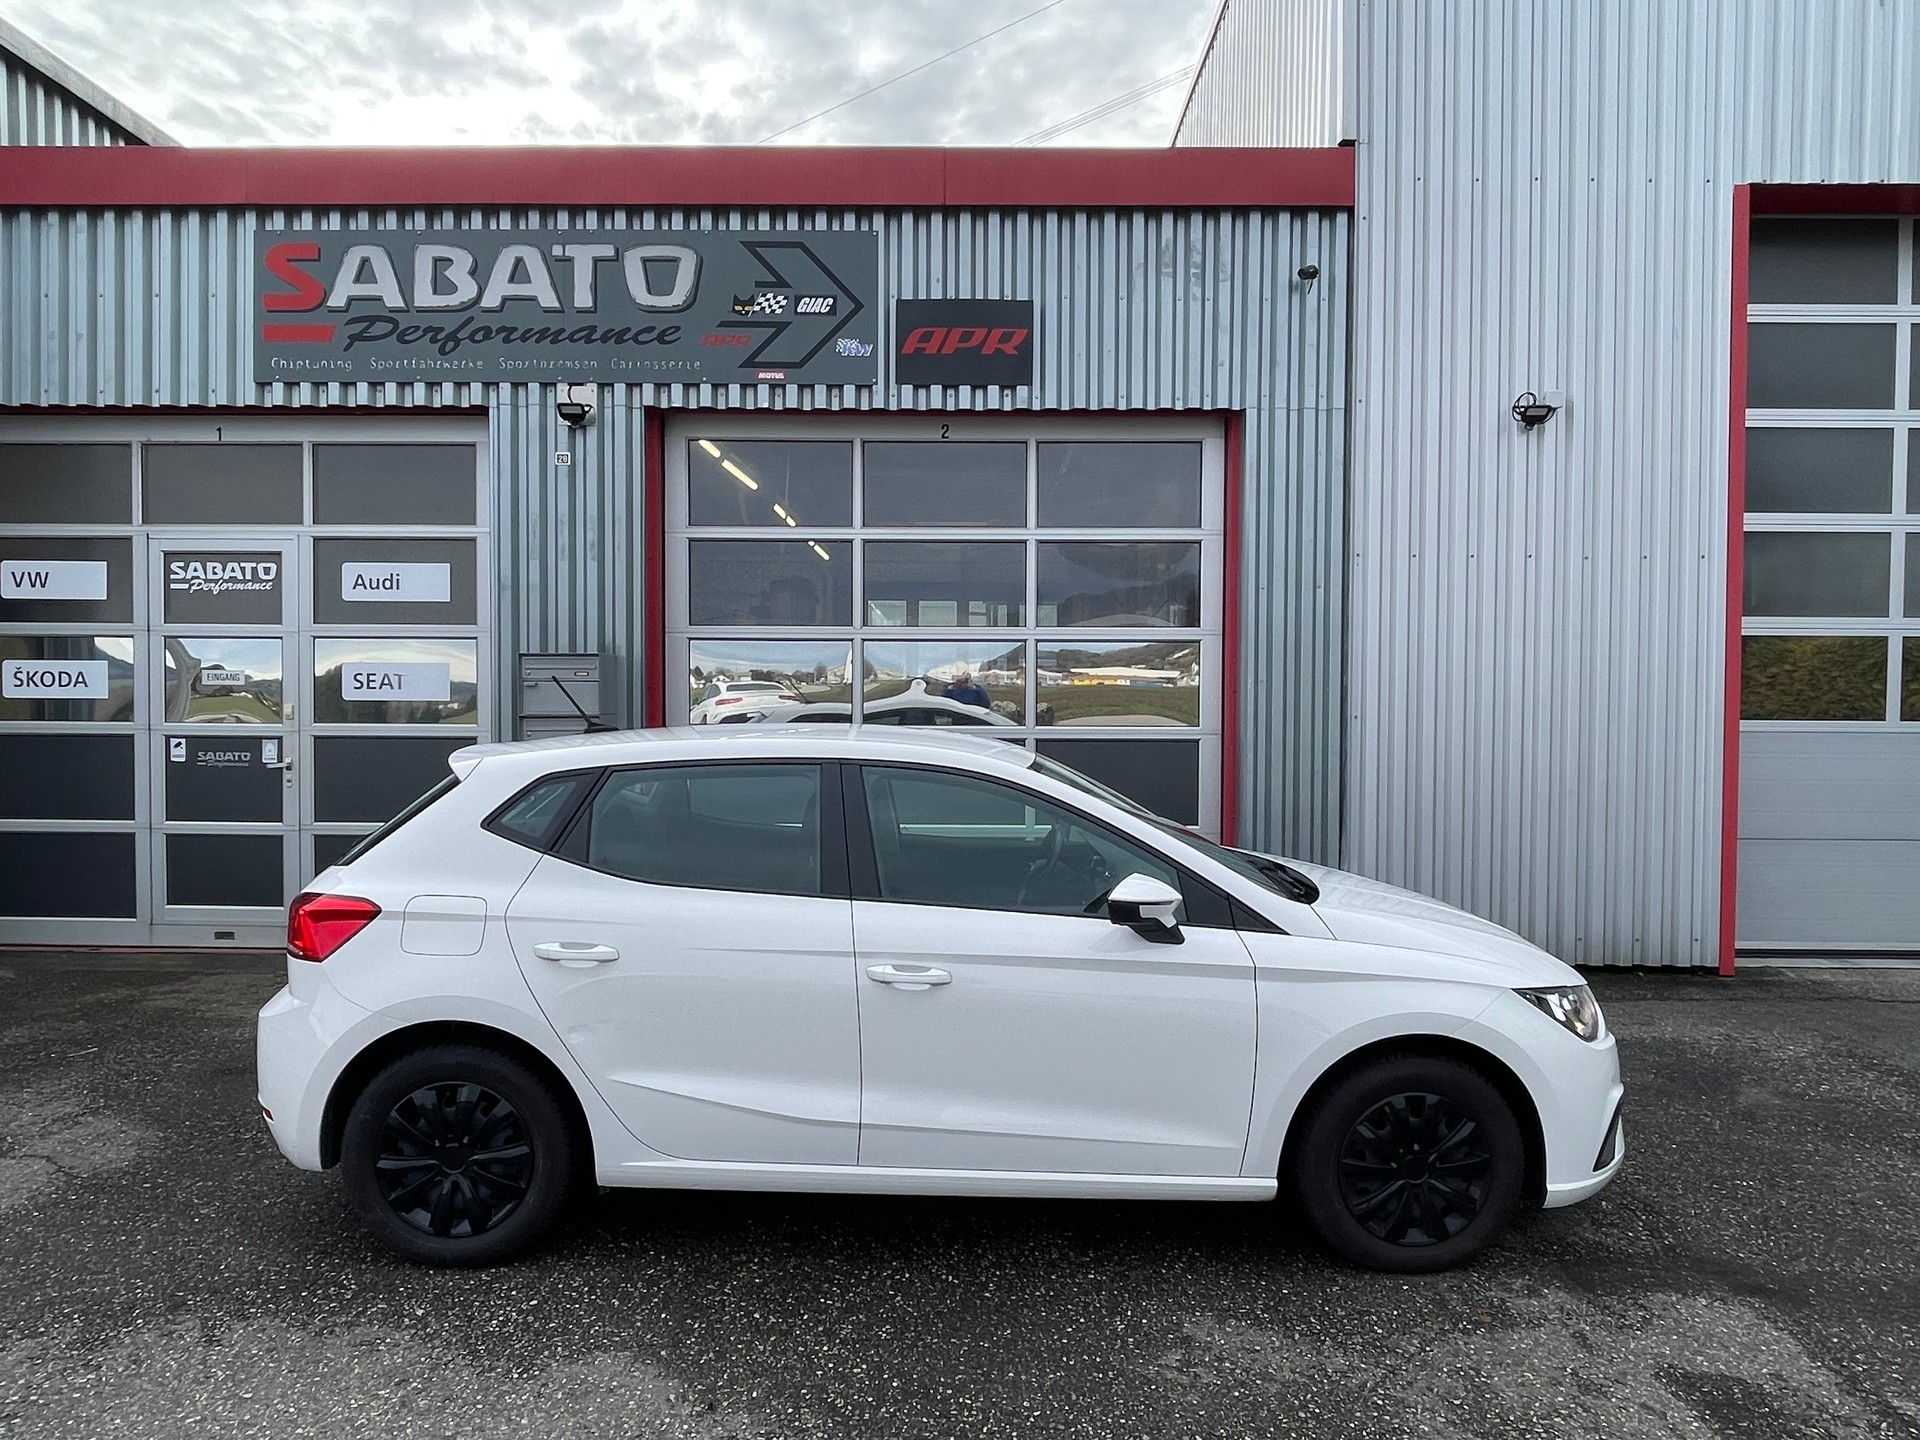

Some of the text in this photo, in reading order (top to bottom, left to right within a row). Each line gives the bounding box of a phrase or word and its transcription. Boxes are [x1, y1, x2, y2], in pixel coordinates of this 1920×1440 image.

[262, 242, 701, 312] SABATO
[796, 297, 833, 314] GIAC
[343, 314, 682, 356] Performance
[902, 327, 1028, 354] APR
[270, 357, 353, 372] Chiptuning
[757, 372, 785, 380] MOTUL
[215, 427, 222, 441] 1
[941, 423, 950, 439] 2
[169, 561, 277, 580] SABATO
[11, 571, 49, 588] VW
[188, 578, 273, 595] Performance
[352, 573, 400, 590] Audi
[13, 666, 89, 688] ŠKODA
[206, 673, 241, 682] EINGANG
[353, 673, 407, 690] SEAT
[197, 751, 251, 761] SABATO
